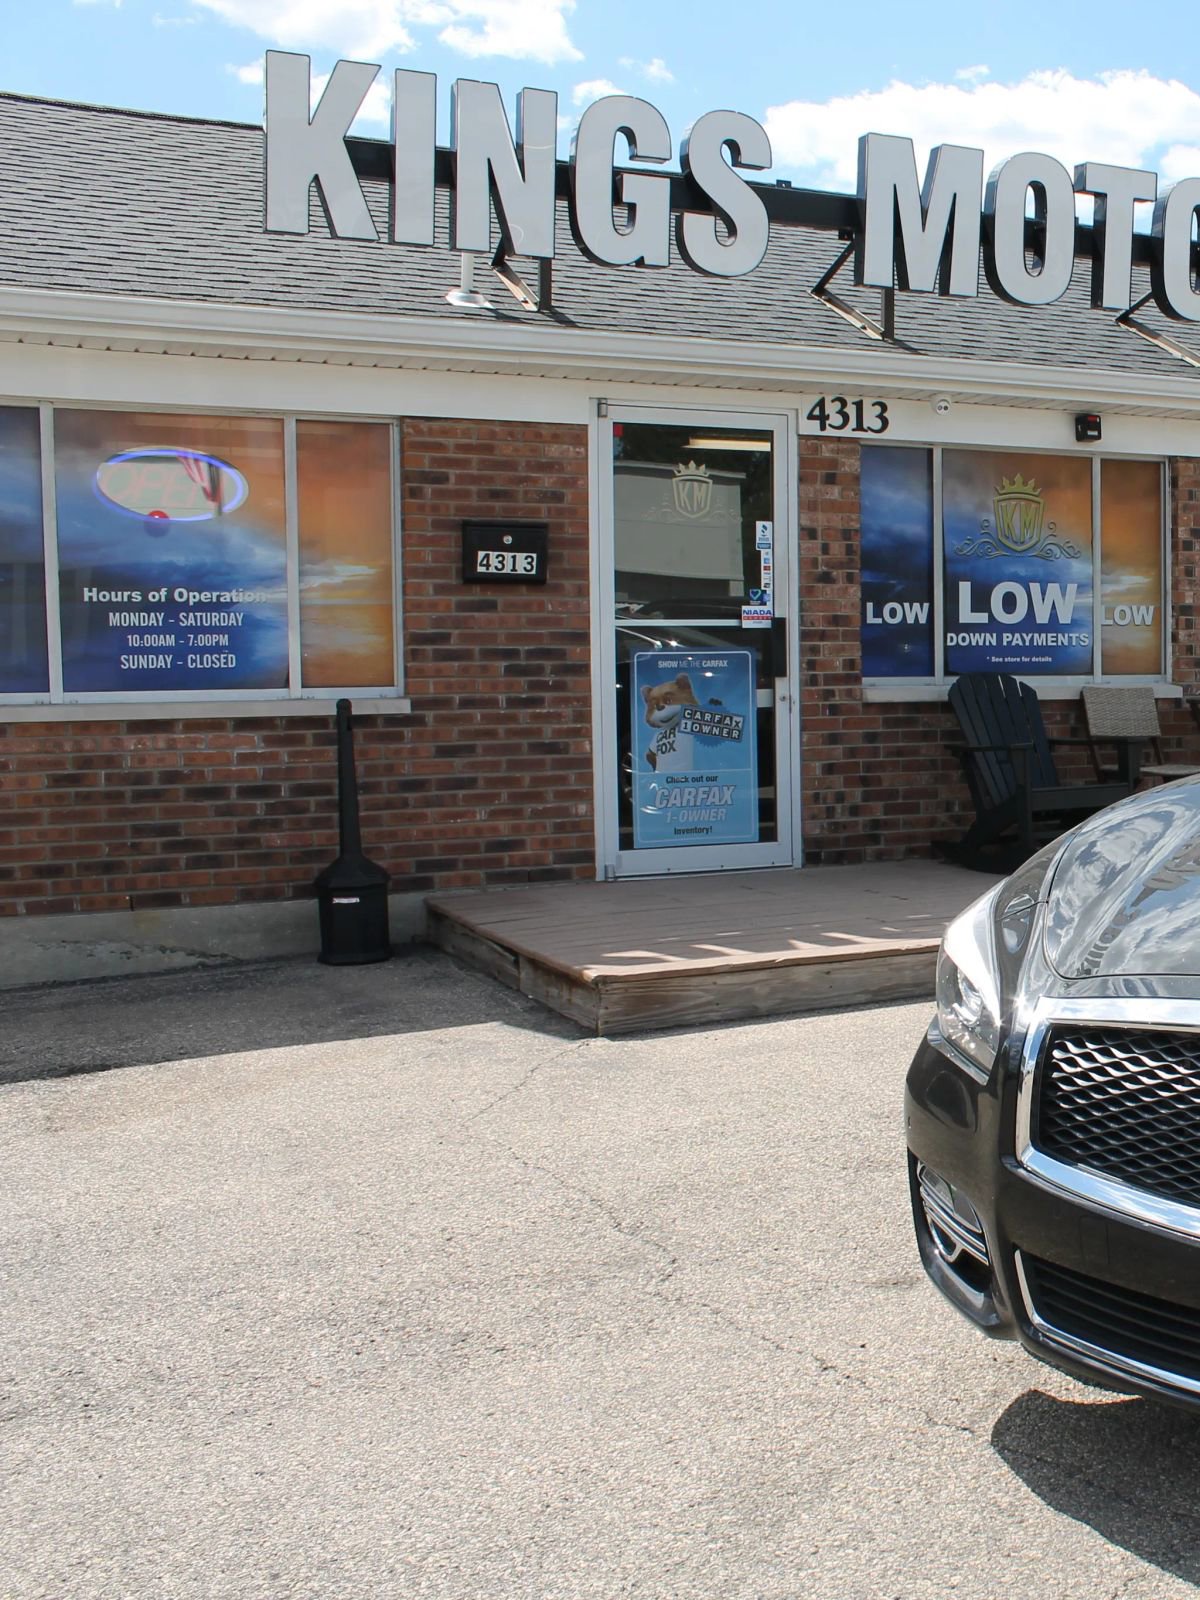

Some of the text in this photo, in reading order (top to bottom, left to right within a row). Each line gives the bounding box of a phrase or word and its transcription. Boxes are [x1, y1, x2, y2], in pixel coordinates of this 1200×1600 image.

[264, 49, 772, 277] KINGS
[806, 396, 889, 434] 4313
[1000, 502, 1038, 543] KM
[479, 552, 535, 573] 4313
[83, 587, 267, 606] Hours of Operation
[958, 581, 1078, 625] LOW
[109, 612, 165, 627] MONDAY
[179, 612, 244, 627] SATURDAY
[866, 602, 929, 624] LOW
[1101, 604, 1155, 626] LOW
[127, 634, 176, 647] 10:00AM
[187, 634, 229, 647] 7:00PM
[947, 632, 1090, 647] DOWN PAYMENTS
[120, 654, 173, 670] SUNDAY
[187, 653, 236, 668] CLOSED
[658, 660, 678, 669] SHOW
[702, 660, 728, 668] CARFAX
[684, 709, 742, 729] CARFAX
[656, 727, 676, 744] CAR
[656, 740, 677, 755] FOX
[691, 775, 704, 783] out
[706, 775, 718, 783] our
[655, 785, 736, 810] CARFAX
[666, 809, 727, 824] 1-OWNER
[674, 826, 713, 835] Inventory!
